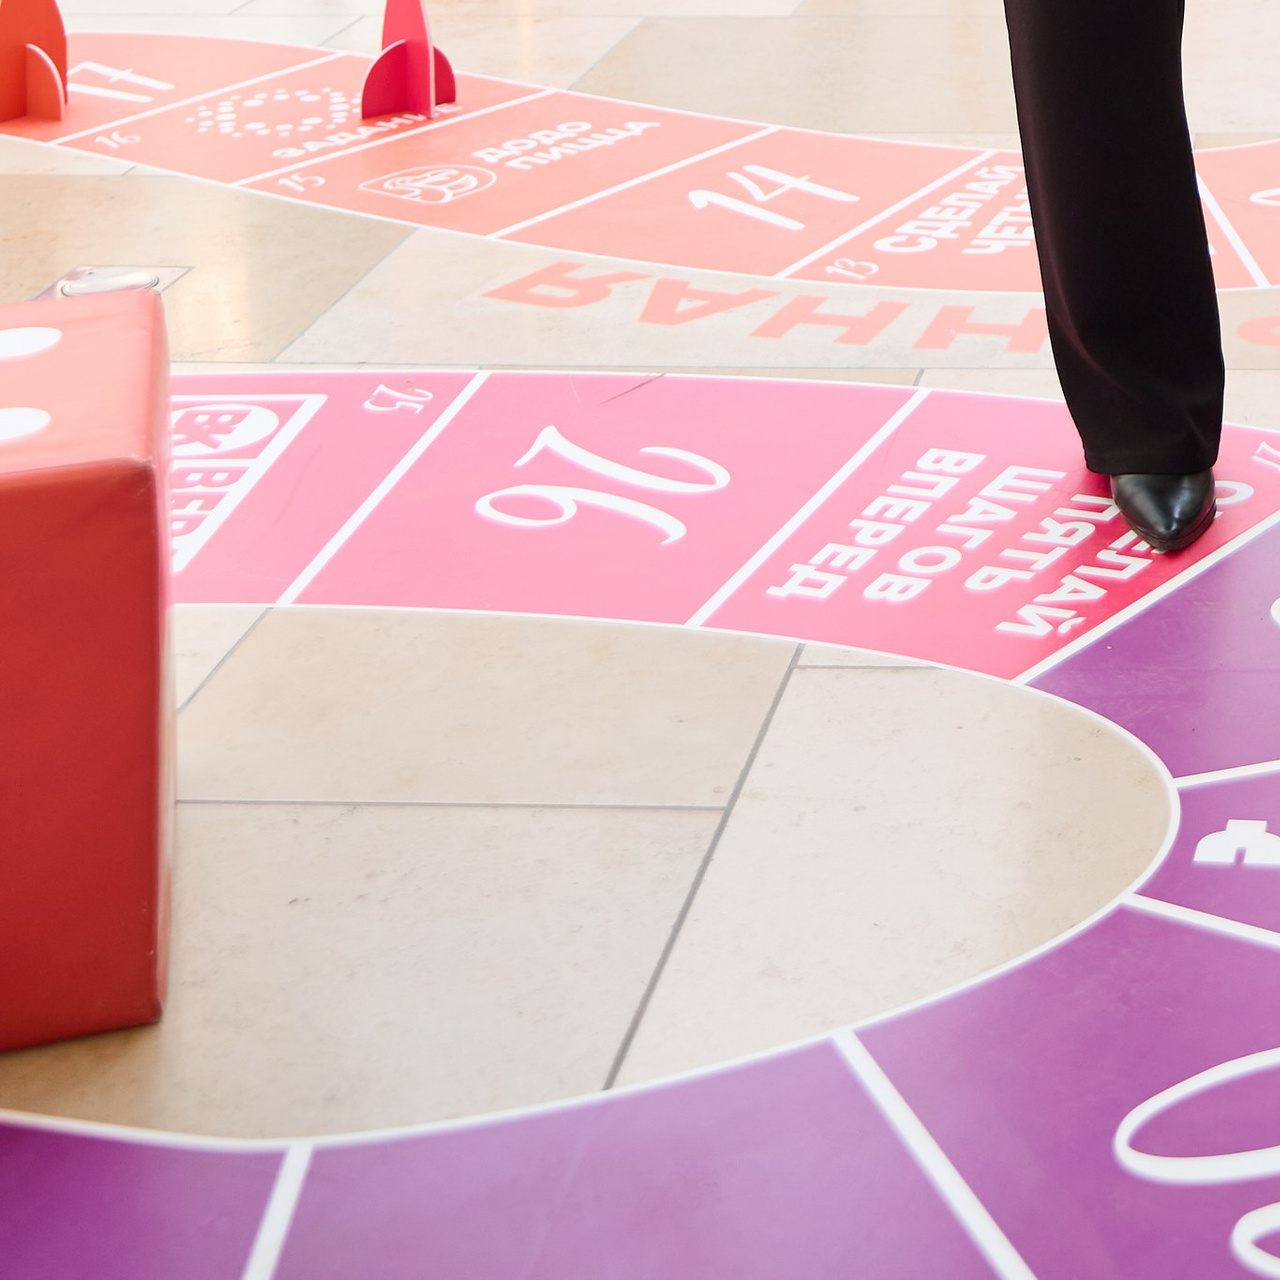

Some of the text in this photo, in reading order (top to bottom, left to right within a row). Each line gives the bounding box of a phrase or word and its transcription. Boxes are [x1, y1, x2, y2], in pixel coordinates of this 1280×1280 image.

[95, 130, 142, 150] 16
[471, 120, 592, 163] ДОДО
[504, 120, 662, 171] ПИЦЦА
[277, 171, 327, 193] 15
[687, 163, 861, 231] 14
[873, 164, 1025, 254] СДЕЛАЙ
[824, 255, 881, 280] 13
[362, 382, 434, 417] 25
[474, 424, 732, 545] 26
[765, 447, 988, 601] ВПЕРЕД
[862, 464, 1068, 603] ШАГОВ
[964, 493, 1120, 593] ПЯТЬ
